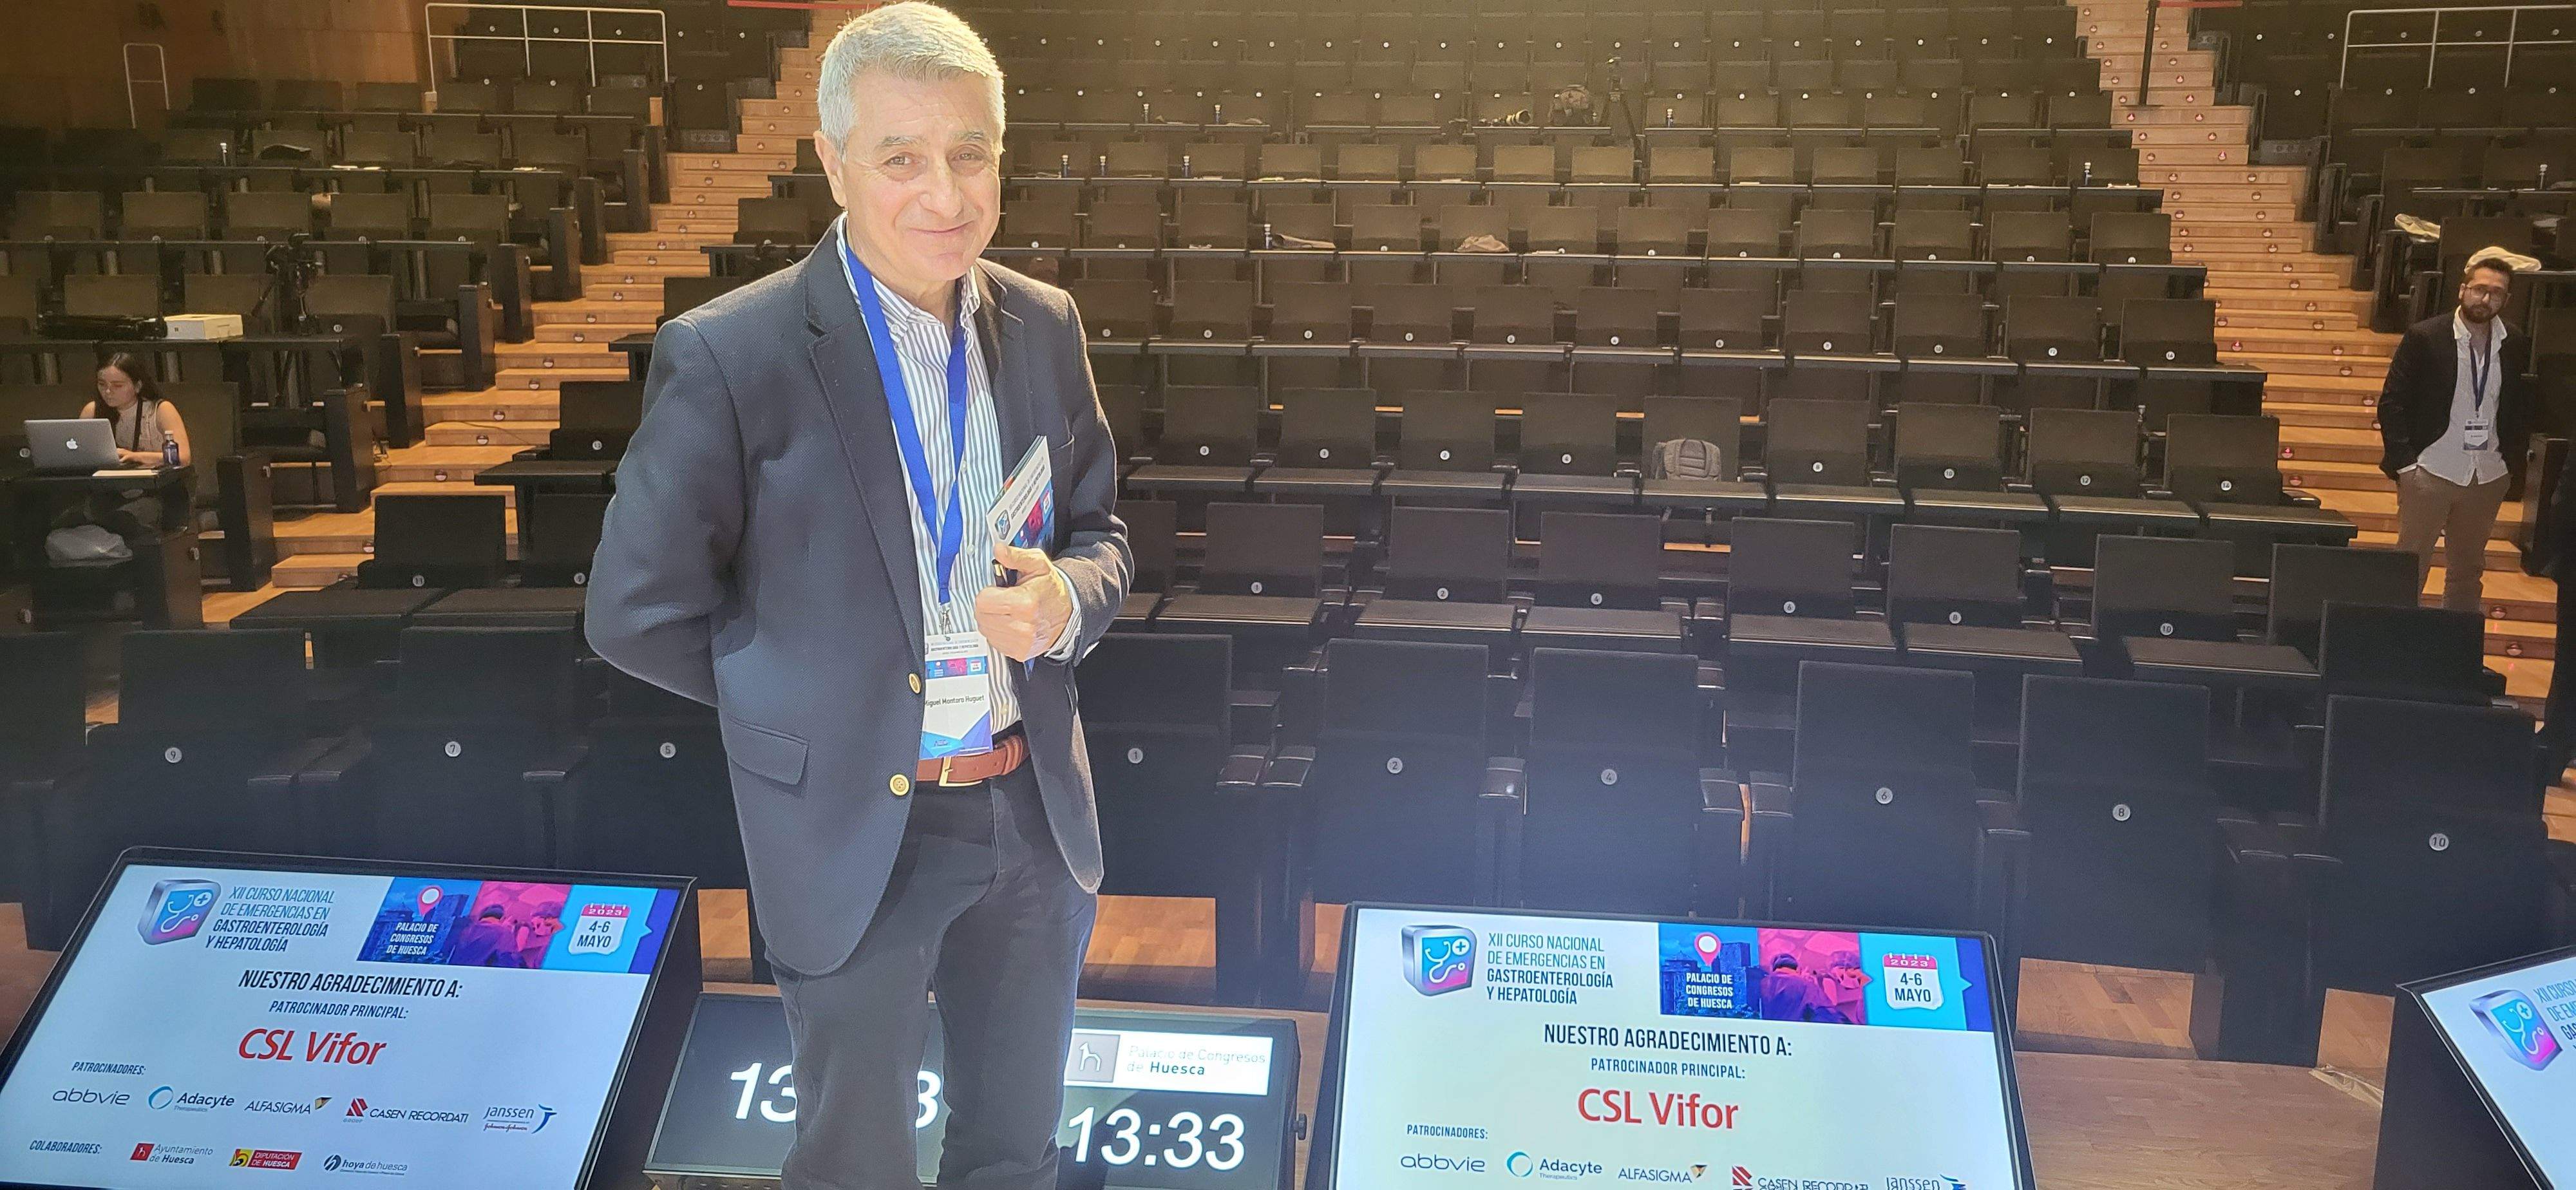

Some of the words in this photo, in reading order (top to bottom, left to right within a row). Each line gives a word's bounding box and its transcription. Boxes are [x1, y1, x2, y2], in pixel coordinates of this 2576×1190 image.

[229, 886, 247, 900] XII
[245, 887, 282, 901] CURSO
[283, 889, 335, 903] NACIONAL
[220, 903, 236, 916] DE
[237, 903, 313, 920] EMERGENCIAS
[312, 907, 330, 920] EN
[213, 919, 329, 937] GASTROENTEROLOGÍA
[395, 922, 426, 932] PALACIO
[426, 923, 439, 933] DE
[589, 920, 611, 932] 4-6
[205, 936, 216, 949] Y
[212, 936, 289, 952] HEPATOLOGÍA
[390, 933, 435, 944] CONGRESOS
[576, 935, 611, 948] MAYO
[1488, 932, 1503, 947] XII
[1506, 934, 1544, 949] CURSO
[1547, 936, 1604, 952] NACIONAL
[386, 945, 399, 954] DE
[399, 945, 427, 956] HUESCA
[1488, 950, 1502, 965] DE
[1506, 951, 1587, 969] EMERGENCIAS
[1590, 956, 1605, 970] EN
[238, 970, 310, 990] NUESTRO
[310, 973, 444, 997] AGRADECIMIENTO
[444, 980, 463, 998] A:
[1487, 968, 1613, 988] GASTROENTEROLOGÍA
[1686, 972, 1719, 984] PALACIO
[1721, 974, 1733, 984] DE
[1900, 972, 1922, 985] 4-6
[1486, 986, 1494, 1000] Y
[1498, 987, 1577, 1005] HEPATOLOGÍA
[1685, 985, 1734, 997] CONGRESOS
[1895, 988, 1931, 1002] MAYO
[2533, 987, 2552, 1003] XII
[269, 1001, 349, 1016] PATROCINADOR
[349, 1005, 409, 1019] PRINCIPAL:
[1687, 997, 1700, 1008] DE
[1701, 997, 1733, 1009] HUESCA
[2546, 1006, 2565, 1021] DE
[238, 1028, 295, 1061] CSL
[306, 1031, 386, 1065] Vifor
[1544, 1024, 1619, 1047] NUESTRO
[1624, 1028, 1770, 1055] AGRADECIMIENTO
[1776, 1036, 1792, 1056] A:
[1129, 1045, 1175, 1059] Palacio
[1179, 1051, 1193, 1059] de
[1197, 1049, 1265, 1064] Congresos
[71, 1061, 147, 1076] PATROCINADORES:
[1127, 1062, 1144, 1072] de
[1150, 1061, 1206, 1075] Huesca
[1591, 1058, 1678, 1075] PATROCINADOR
[1681, 1063, 1745, 1079] PRINCIPAL:
[52, 1088, 130, 1105] abbvie
[176, 1092, 235, 1109] Adacyte
[244, 1100, 311, 1115] ALFASIGMA
[1577, 1088, 1642, 1124] CSL
[1649, 1092, 1739, 1129] Vifor
[370, 1108, 407, 1119] CASEN
[408, 1110, 469, 1123] RECORDATI
[1068, 1107, 1245, 1171] 13:33
[1407, 1124, 1488, 1139] PATROCINADORES:
[30, 1140, 102, 1155] COLABORADORES:
[154, 1144, 214, 1157] Ayuntamiento
[149, 1154, 160, 1162] de
[162, 1155, 194, 1164] Huesca
[254, 1152, 295, 1160] DIPUTACIÓN
[1401, 1154, 1485, 1172] abbvie
[342, 1159, 365, 1169] hoya
[1539, 1158, 1602, 1176] Adacyte
[1618, 1168, 1692, 1183] ALFASIGMA
